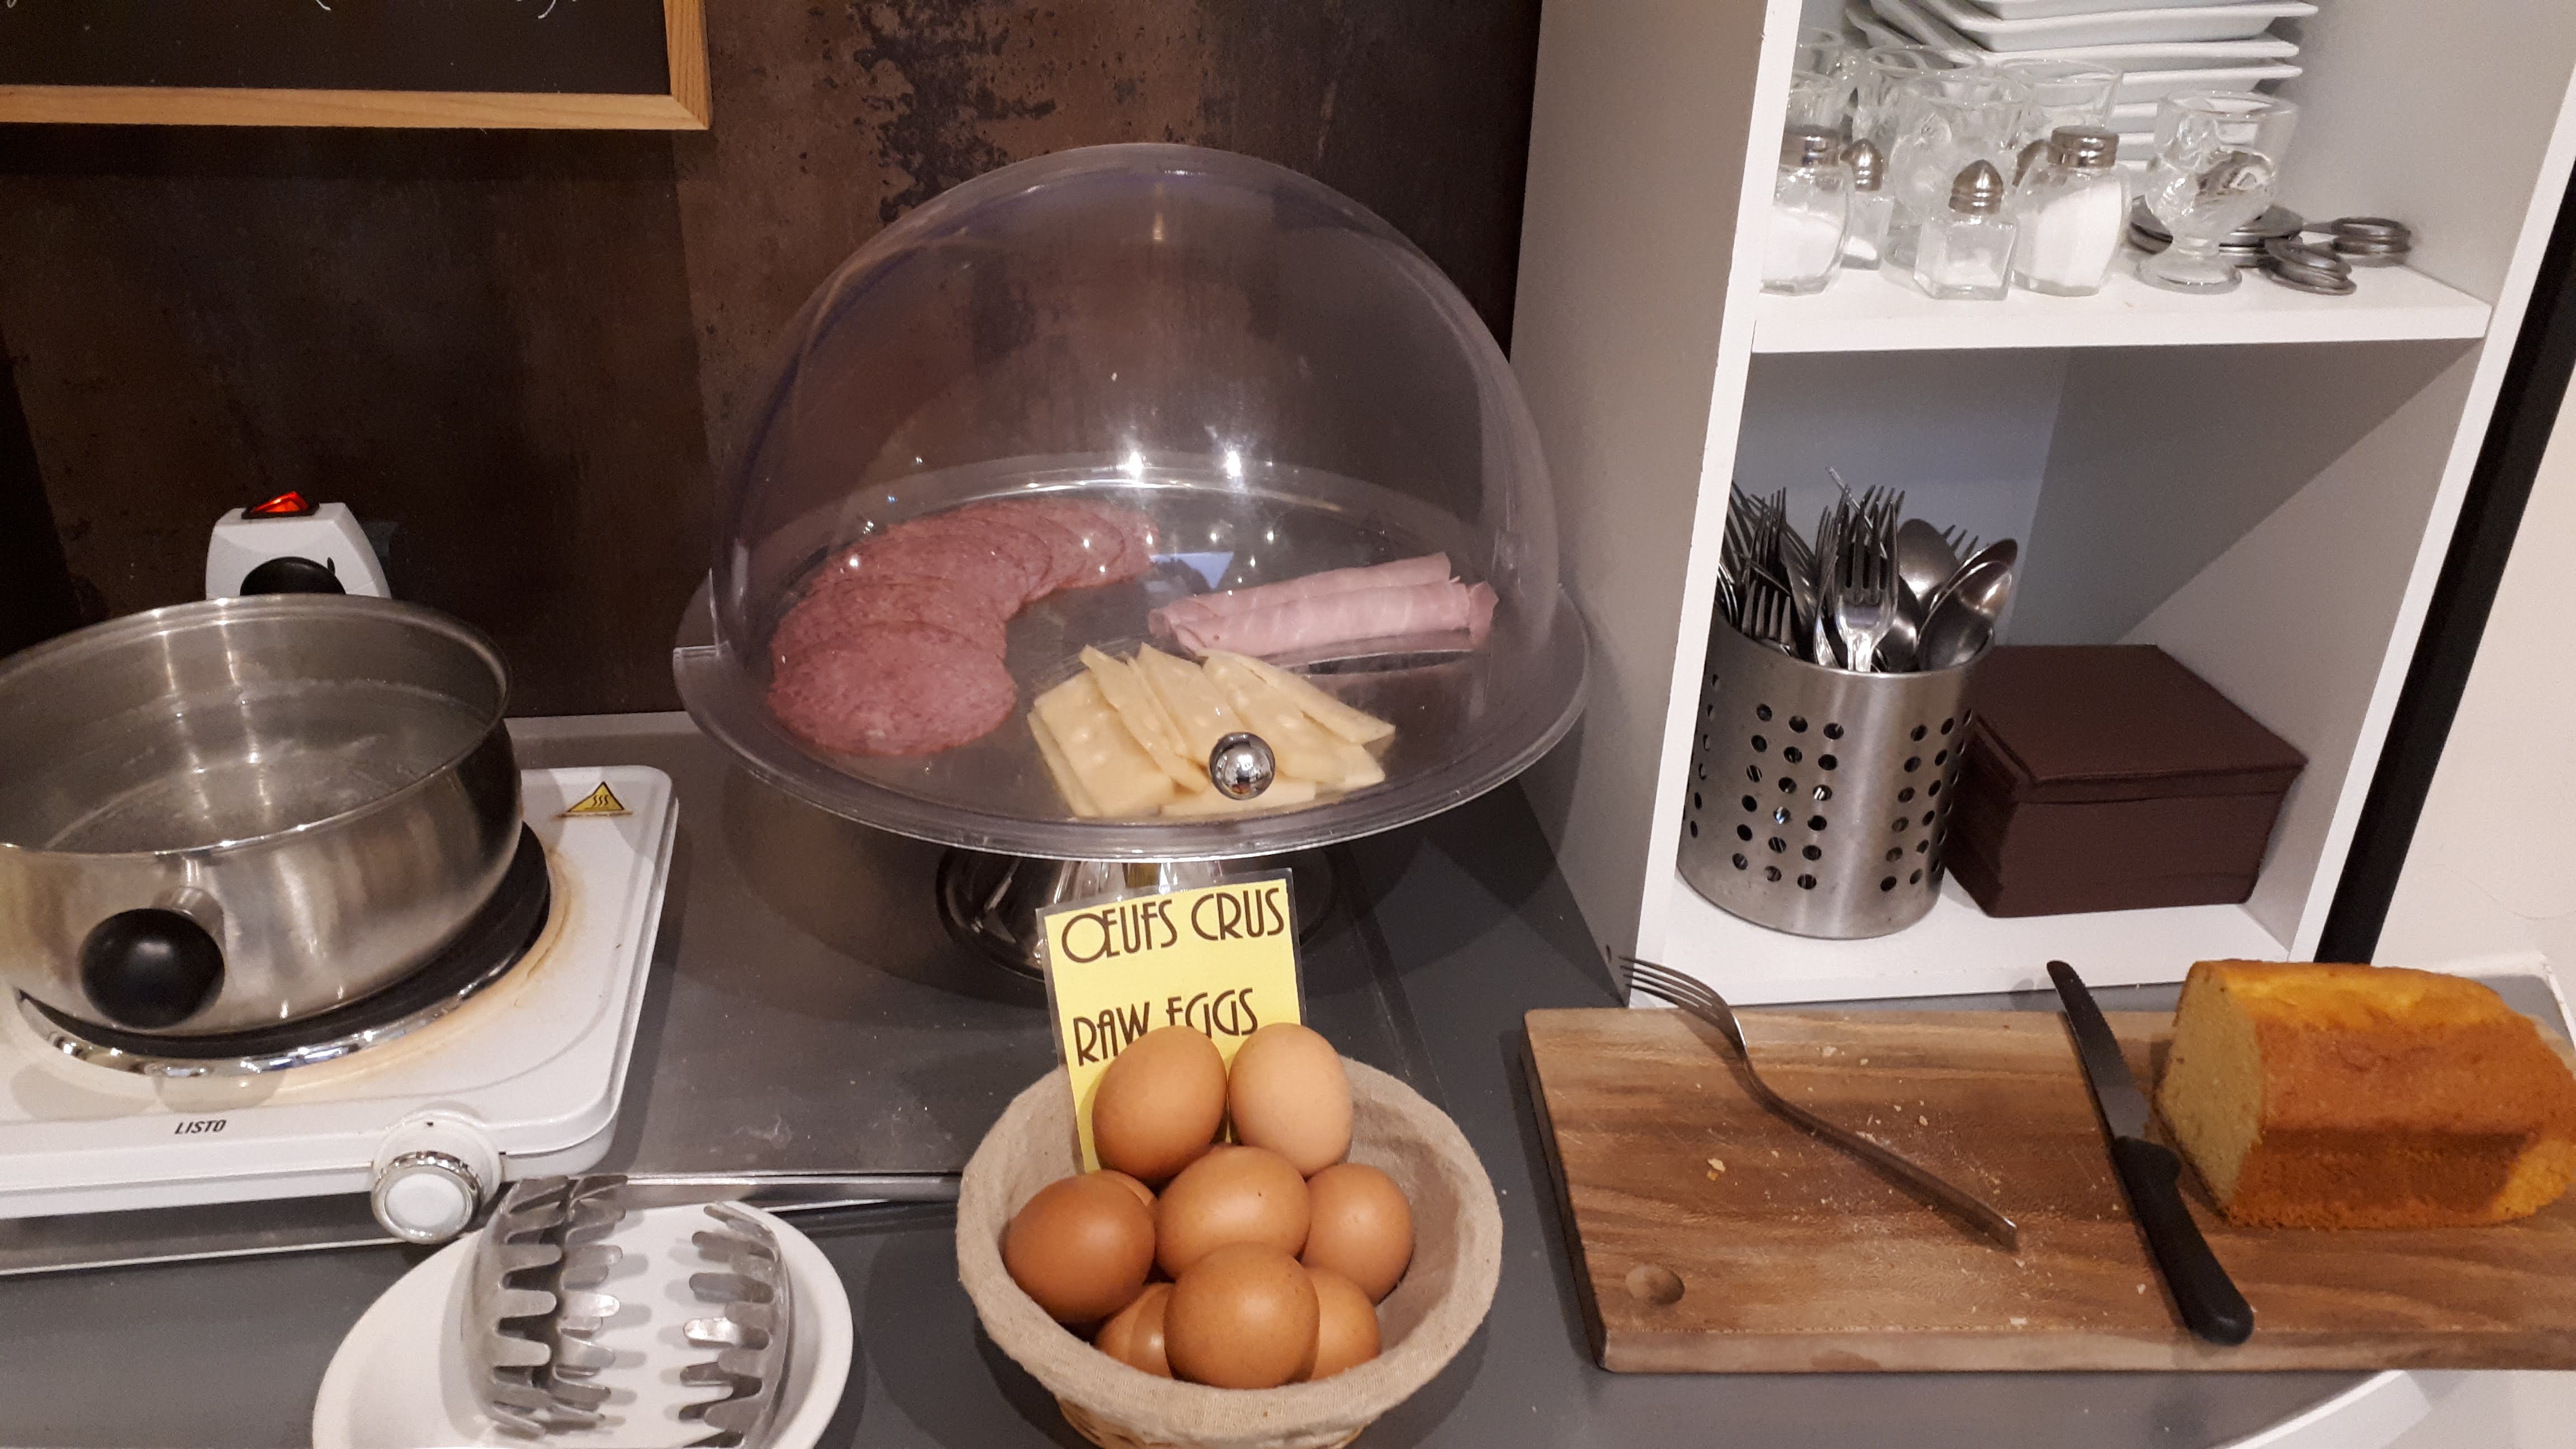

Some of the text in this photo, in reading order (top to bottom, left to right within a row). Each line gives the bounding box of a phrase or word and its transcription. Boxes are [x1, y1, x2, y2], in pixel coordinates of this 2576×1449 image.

[1062, 888, 1285, 963] ŒUFS CRUS
[1073, 1001, 1150, 1067] RAW
[174, 1119, 228, 1135] LISTO
